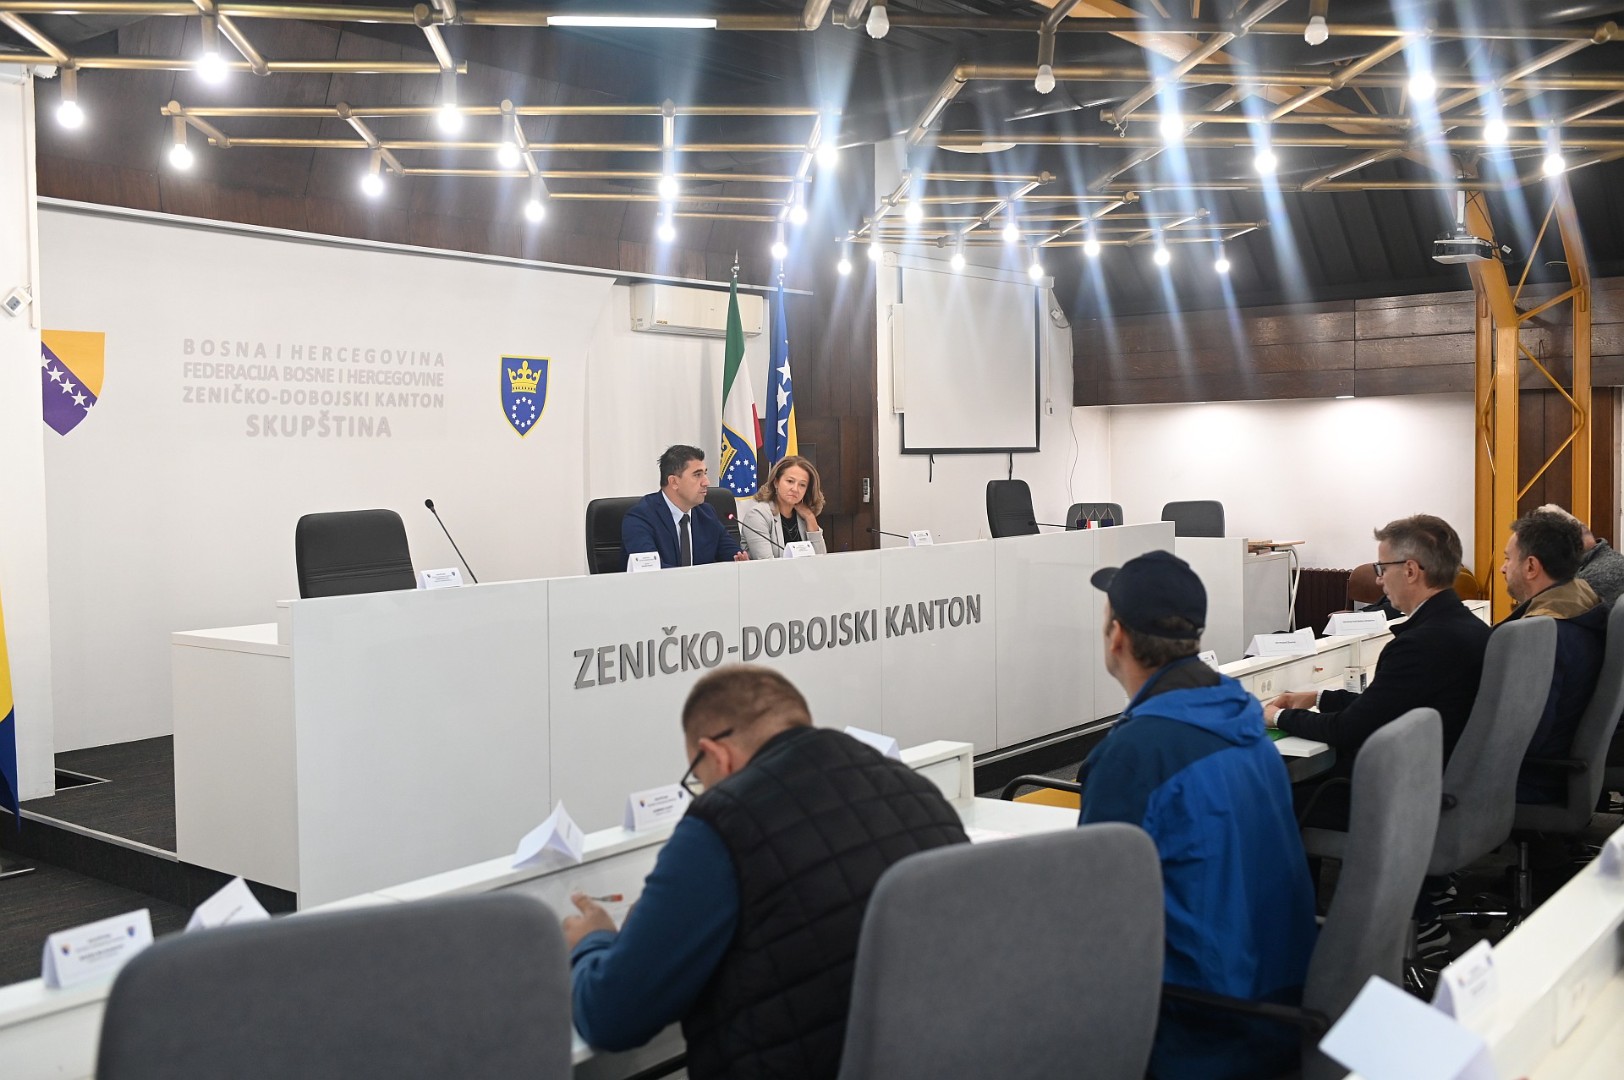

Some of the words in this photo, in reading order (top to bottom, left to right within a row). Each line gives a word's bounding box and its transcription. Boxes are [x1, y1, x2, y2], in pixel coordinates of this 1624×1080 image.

[183, 338, 267, 359] BOSNA
[276, 343, 282, 359] I
[291, 344, 445, 367] HERCEGOVINA
[183, 362, 279, 381] FEDERACIJA
[283, 366, 335, 383] BOSNE
[338, 368, 343, 384] I
[347, 369, 444, 387] HERCEGOVINE
[182, 384, 370, 408] ZENIČKO-DOBOJSKI
[375, 391, 444, 408] KANTON
[246, 410, 392, 438] SKUPŠTINA
[573, 609, 878, 690] ZENIČKO-DOBOJSKI
[885, 593, 982, 638] KANTON
